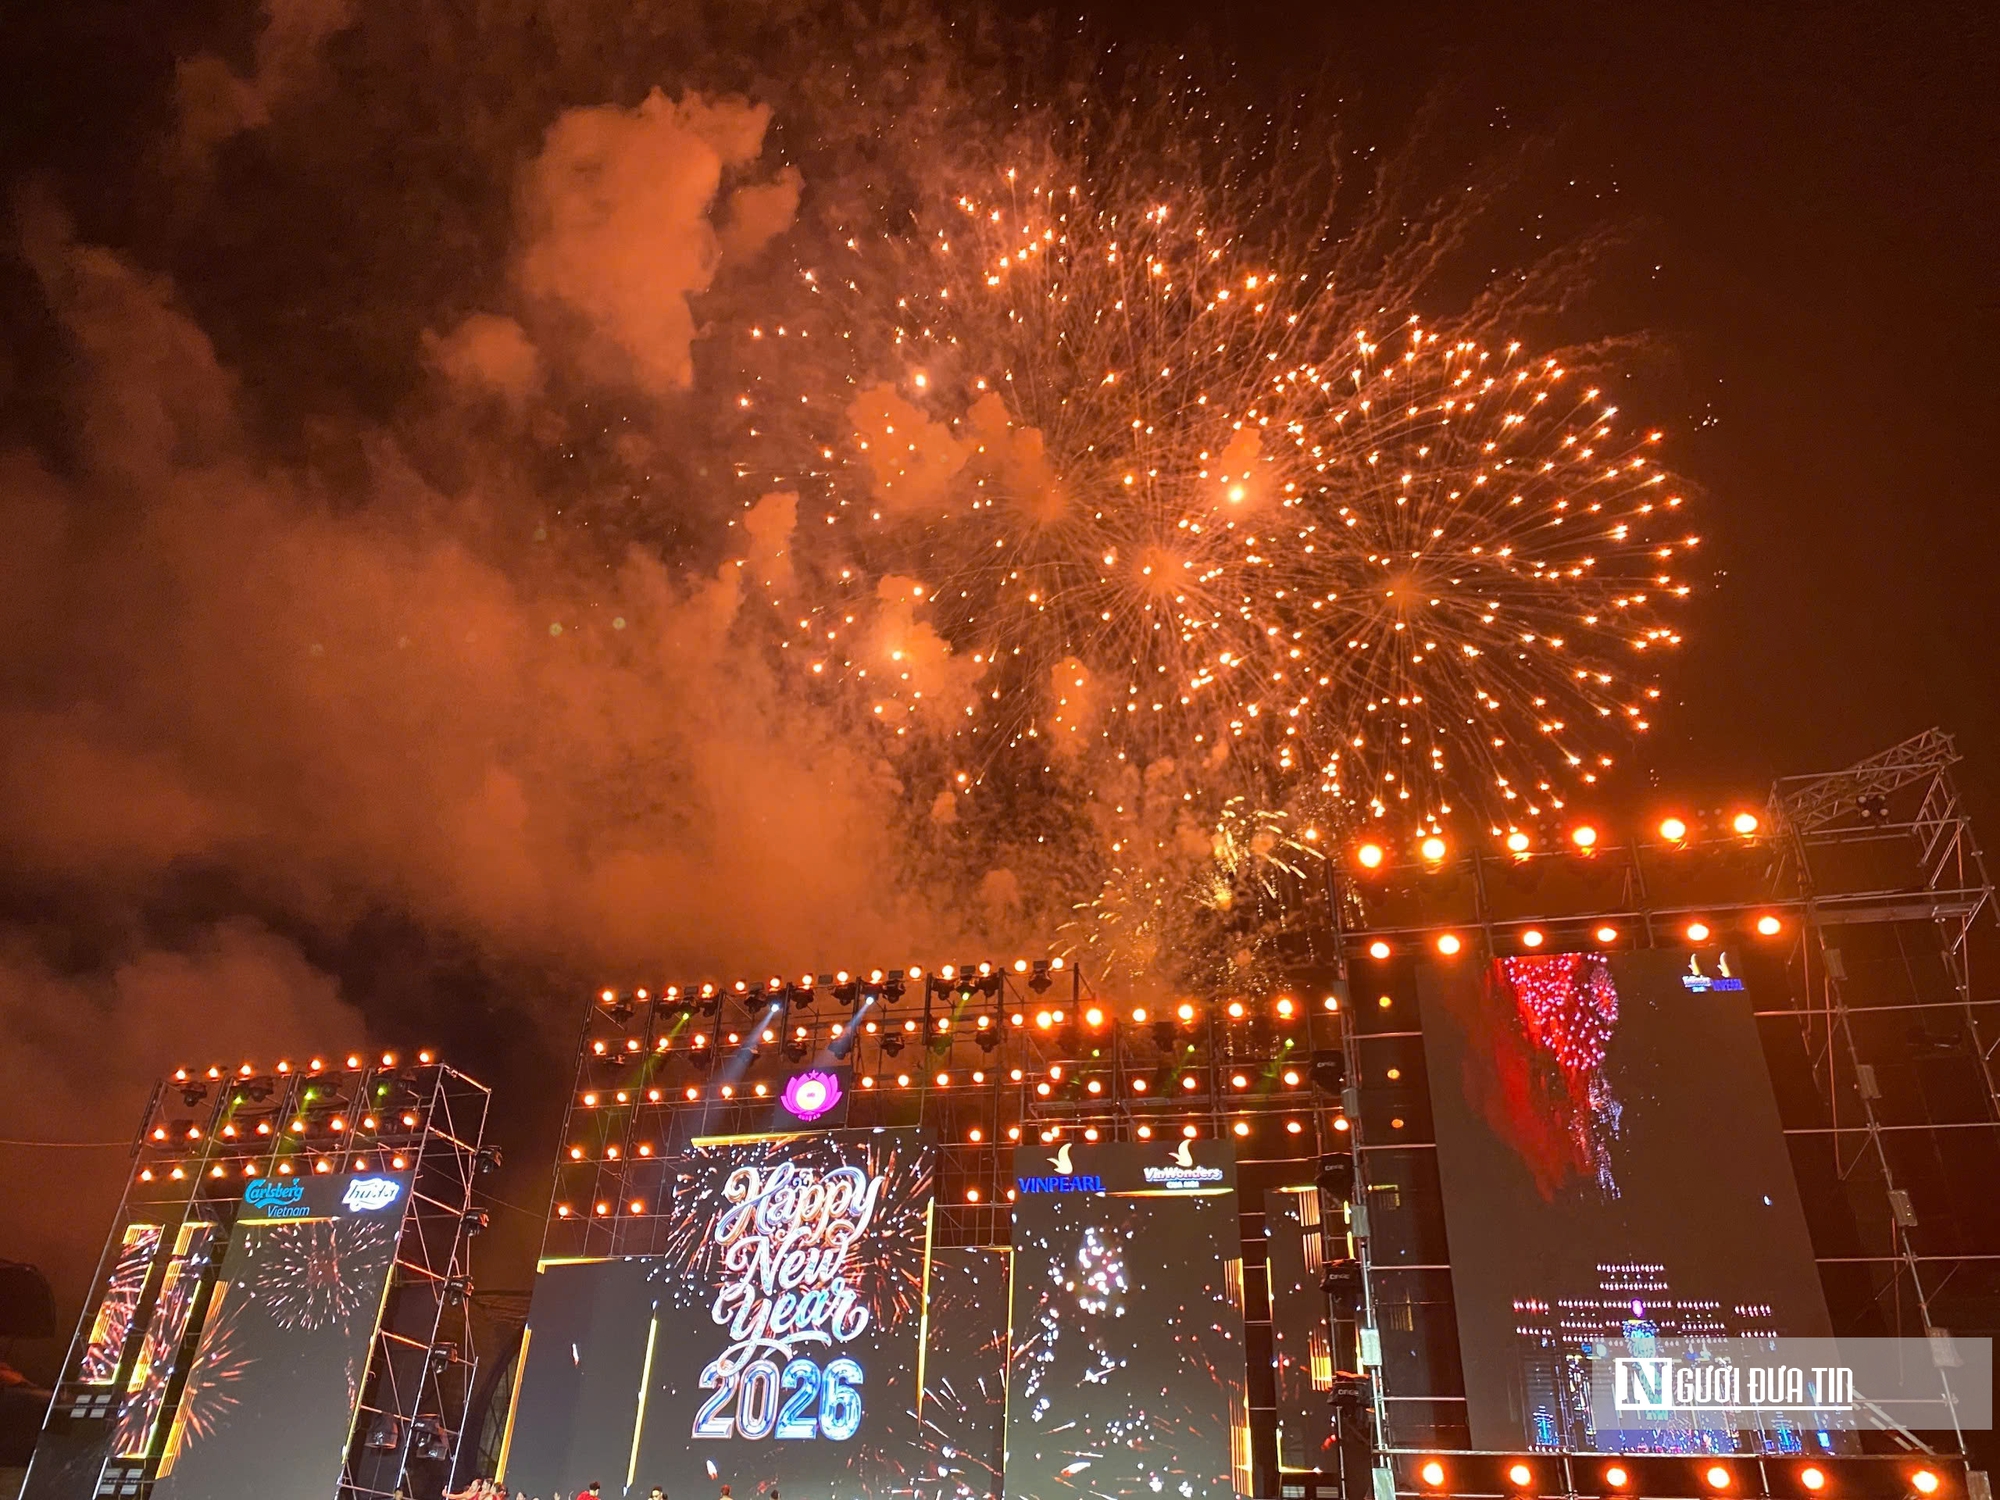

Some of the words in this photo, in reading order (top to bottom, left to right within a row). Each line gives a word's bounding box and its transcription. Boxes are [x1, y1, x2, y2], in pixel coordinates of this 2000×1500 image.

[245, 1178, 304, 1206] Carlsberg
[1018, 1175, 1106, 1193] VINPEARL
[1143, 1166, 1223, 1182] VinWonders
[267, 1206, 310, 1217] Vietnam
[715, 1162, 885, 1246] Happy
[722, 1225, 851, 1296] New
[712, 1278, 869, 1376] Year
[691, 1359, 864, 1440] 2026
